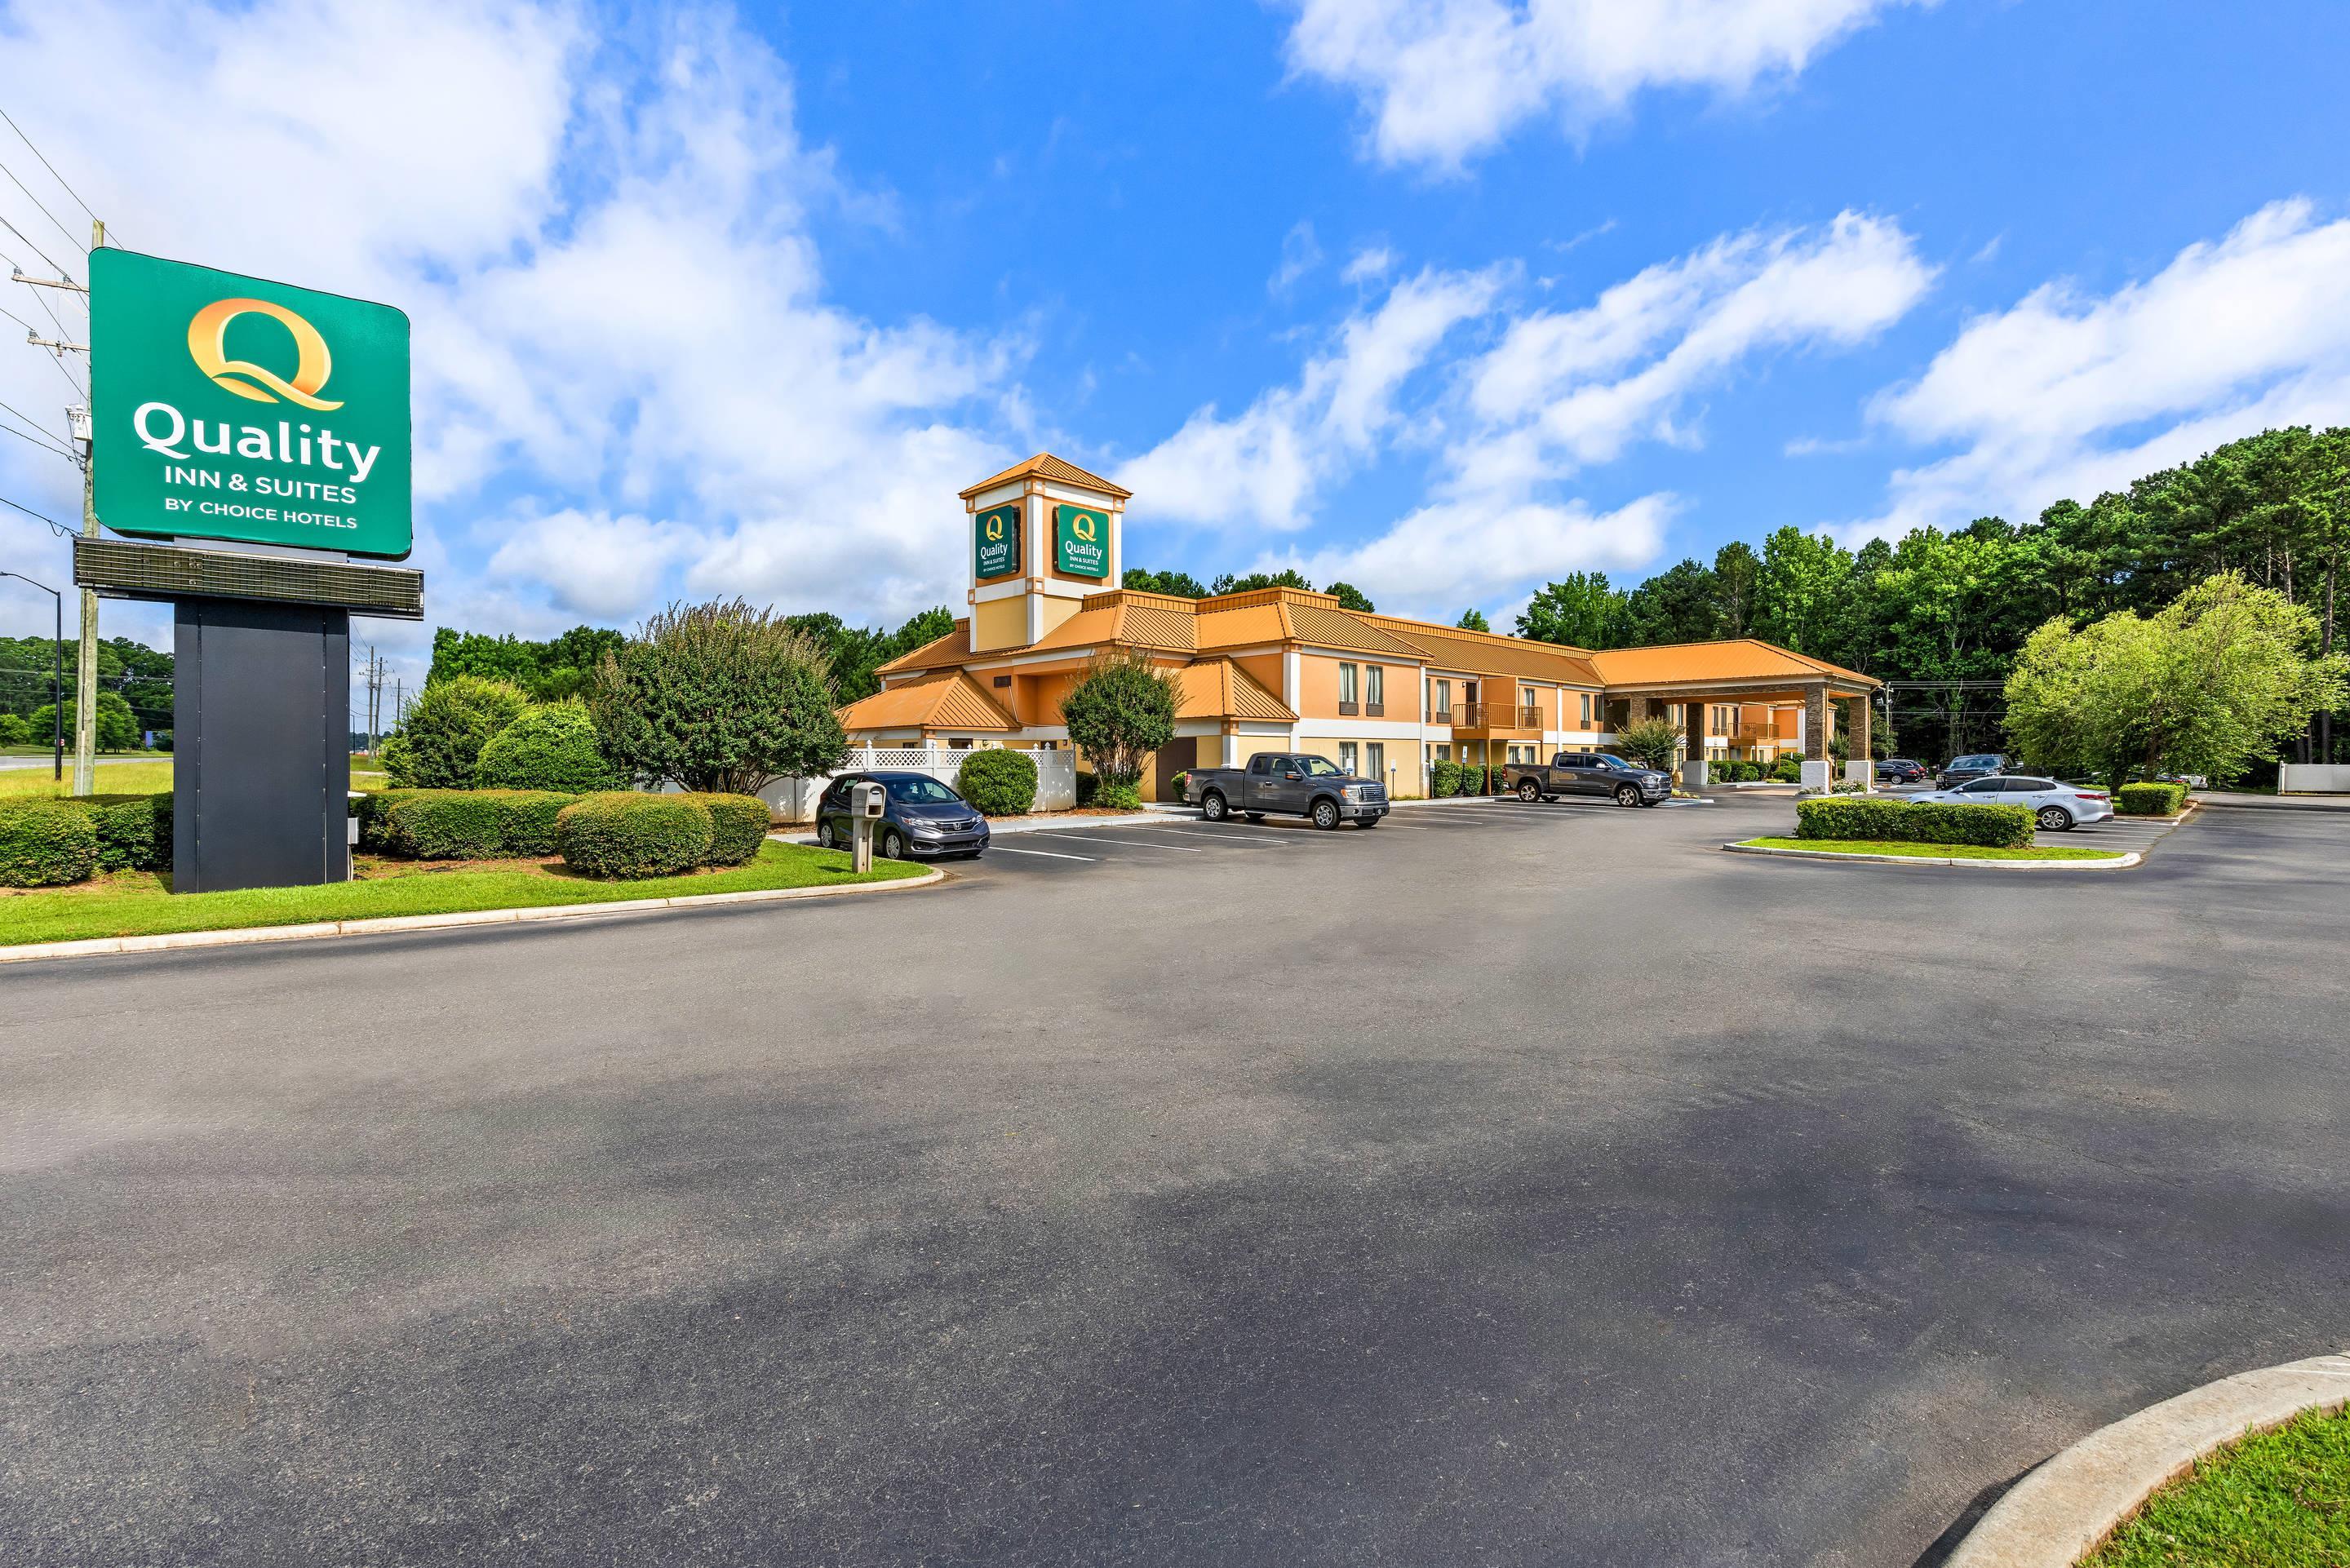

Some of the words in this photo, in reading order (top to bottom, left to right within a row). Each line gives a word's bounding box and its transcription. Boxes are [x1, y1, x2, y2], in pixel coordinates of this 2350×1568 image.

[188, 298, 345, 411] Q
[133, 401, 381, 483] Quality
[165, 465, 220, 489] INN
[228, 473, 248, 492] &
[255, 476, 357, 504] SUITES
[165, 498, 193, 512] BY
[199, 502, 278, 521] CHOICE
[283, 510, 357, 529] HOTELS
[986, 514, 1004, 541] Q
[1072, 514, 1097, 541] Q
[981, 543, 1008, 560] Quality
[1065, 540, 1102, 560] Quality
